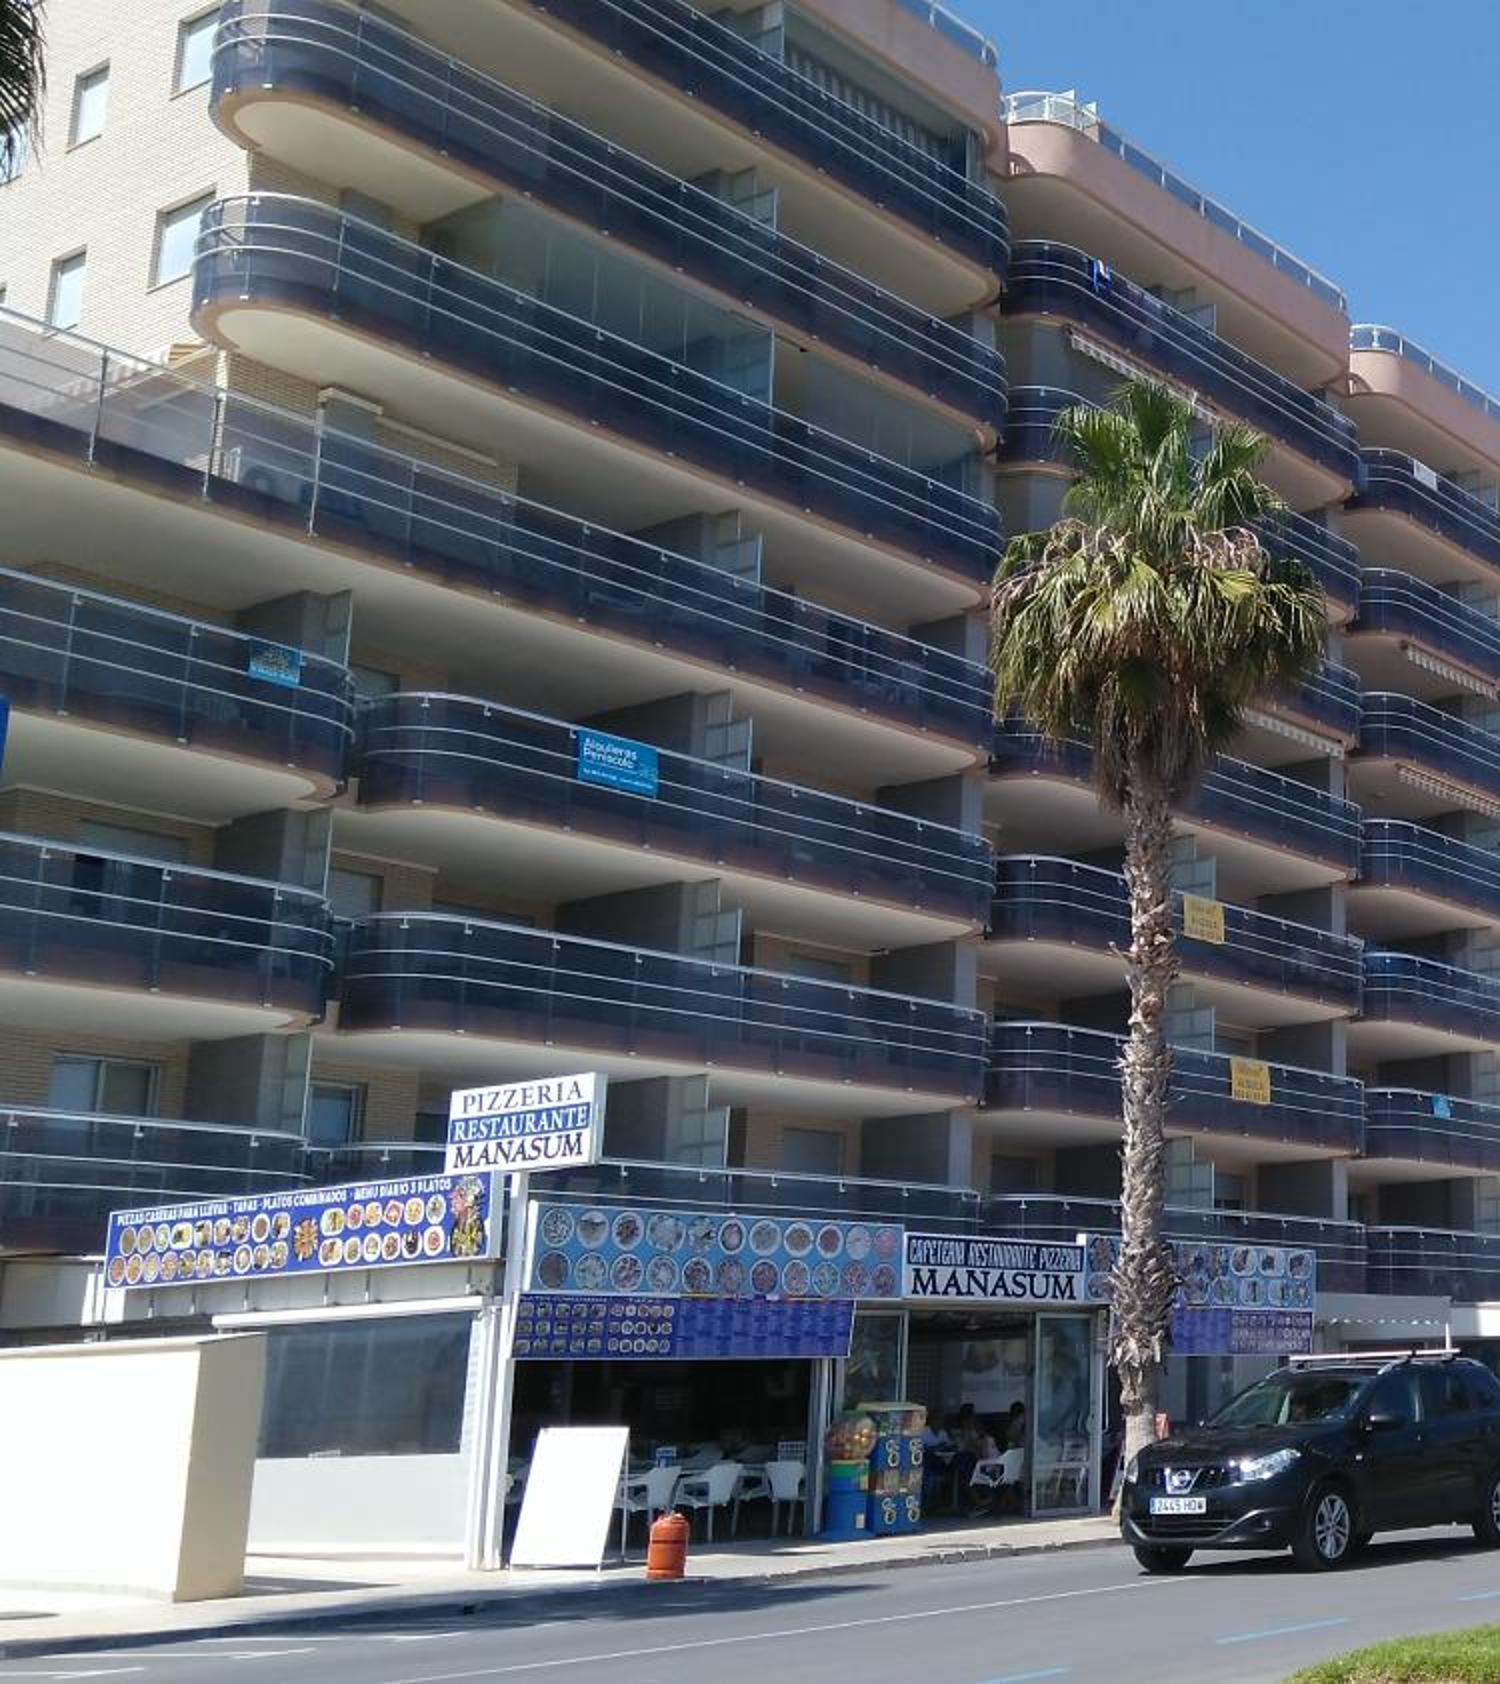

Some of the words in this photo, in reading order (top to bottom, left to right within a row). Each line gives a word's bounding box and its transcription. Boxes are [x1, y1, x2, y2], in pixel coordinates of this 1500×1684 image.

[462, 1080, 584, 1115] PIZZERIA
[453, 1105, 588, 1142] RESTAURANTE
[453, 1132, 584, 1169] MANASUM
[417, 1178, 452, 1194] PLATOS
[909, 1238, 966, 1265] CAFETERIA
[1039, 1247, 1082, 1271] PIZZERIA
[911, 1268, 1077, 1300] MANASUM
